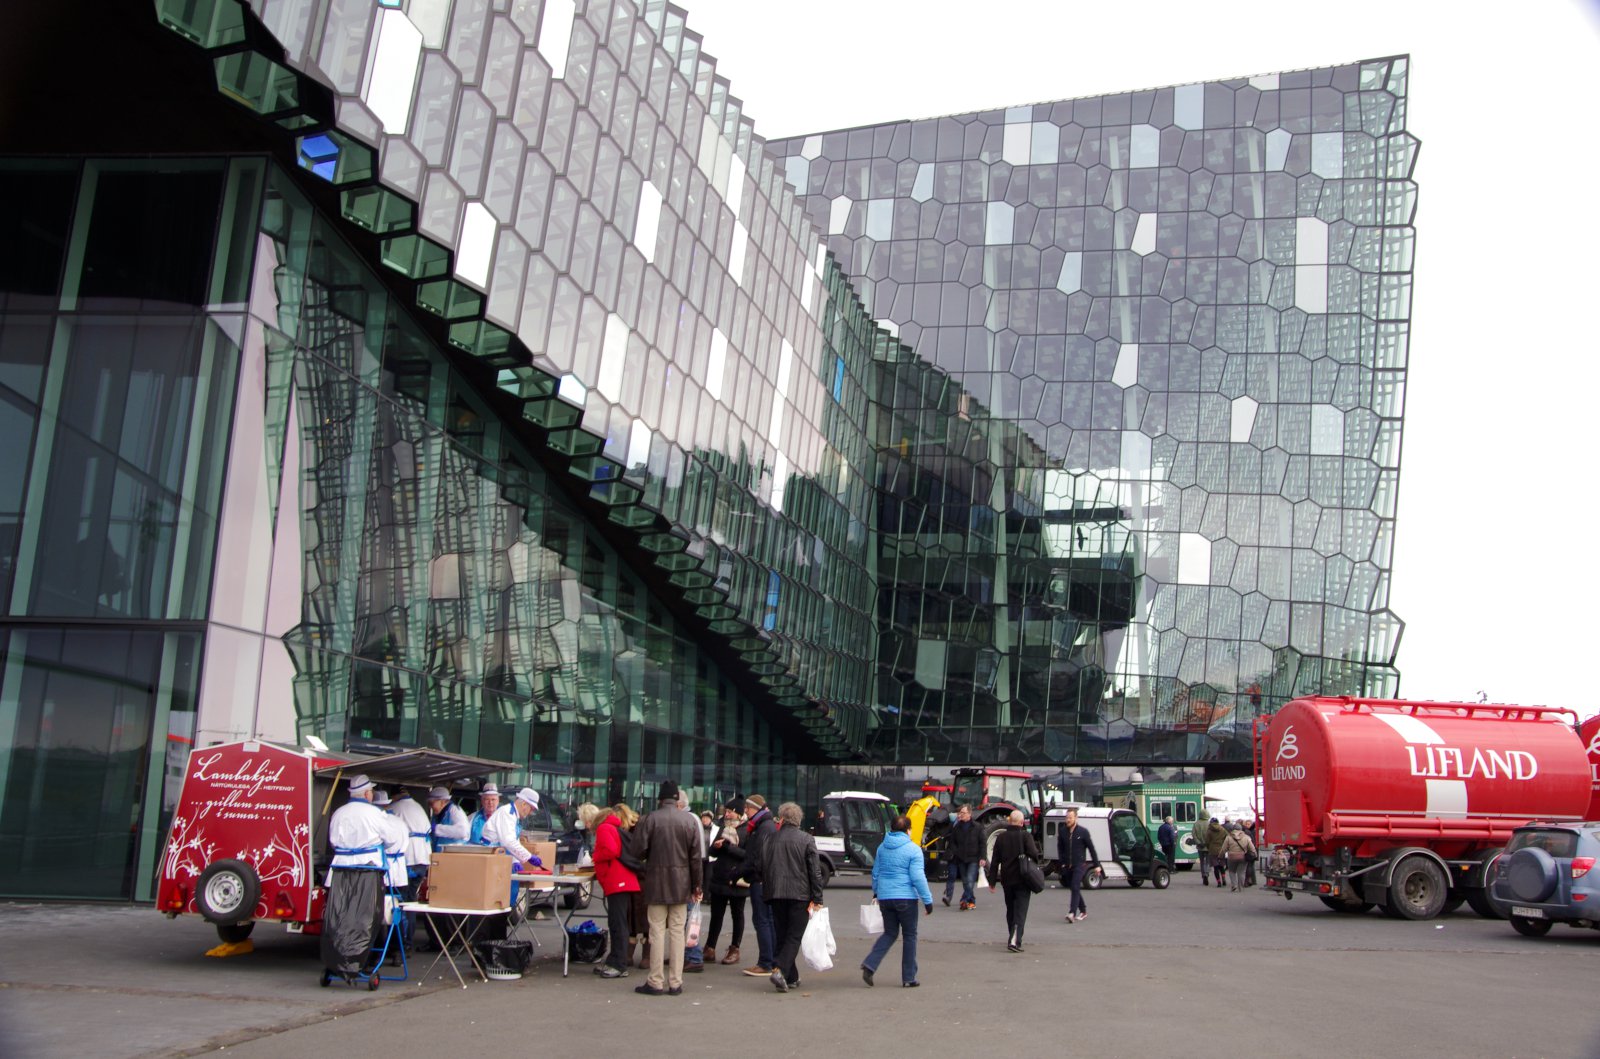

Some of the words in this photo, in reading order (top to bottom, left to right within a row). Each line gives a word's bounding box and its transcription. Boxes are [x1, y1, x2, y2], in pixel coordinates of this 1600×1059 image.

[192, 752, 286, 797] Lambakjöt
[199, 789, 253, 820] grillum
[254, 802, 293, 811] saman
